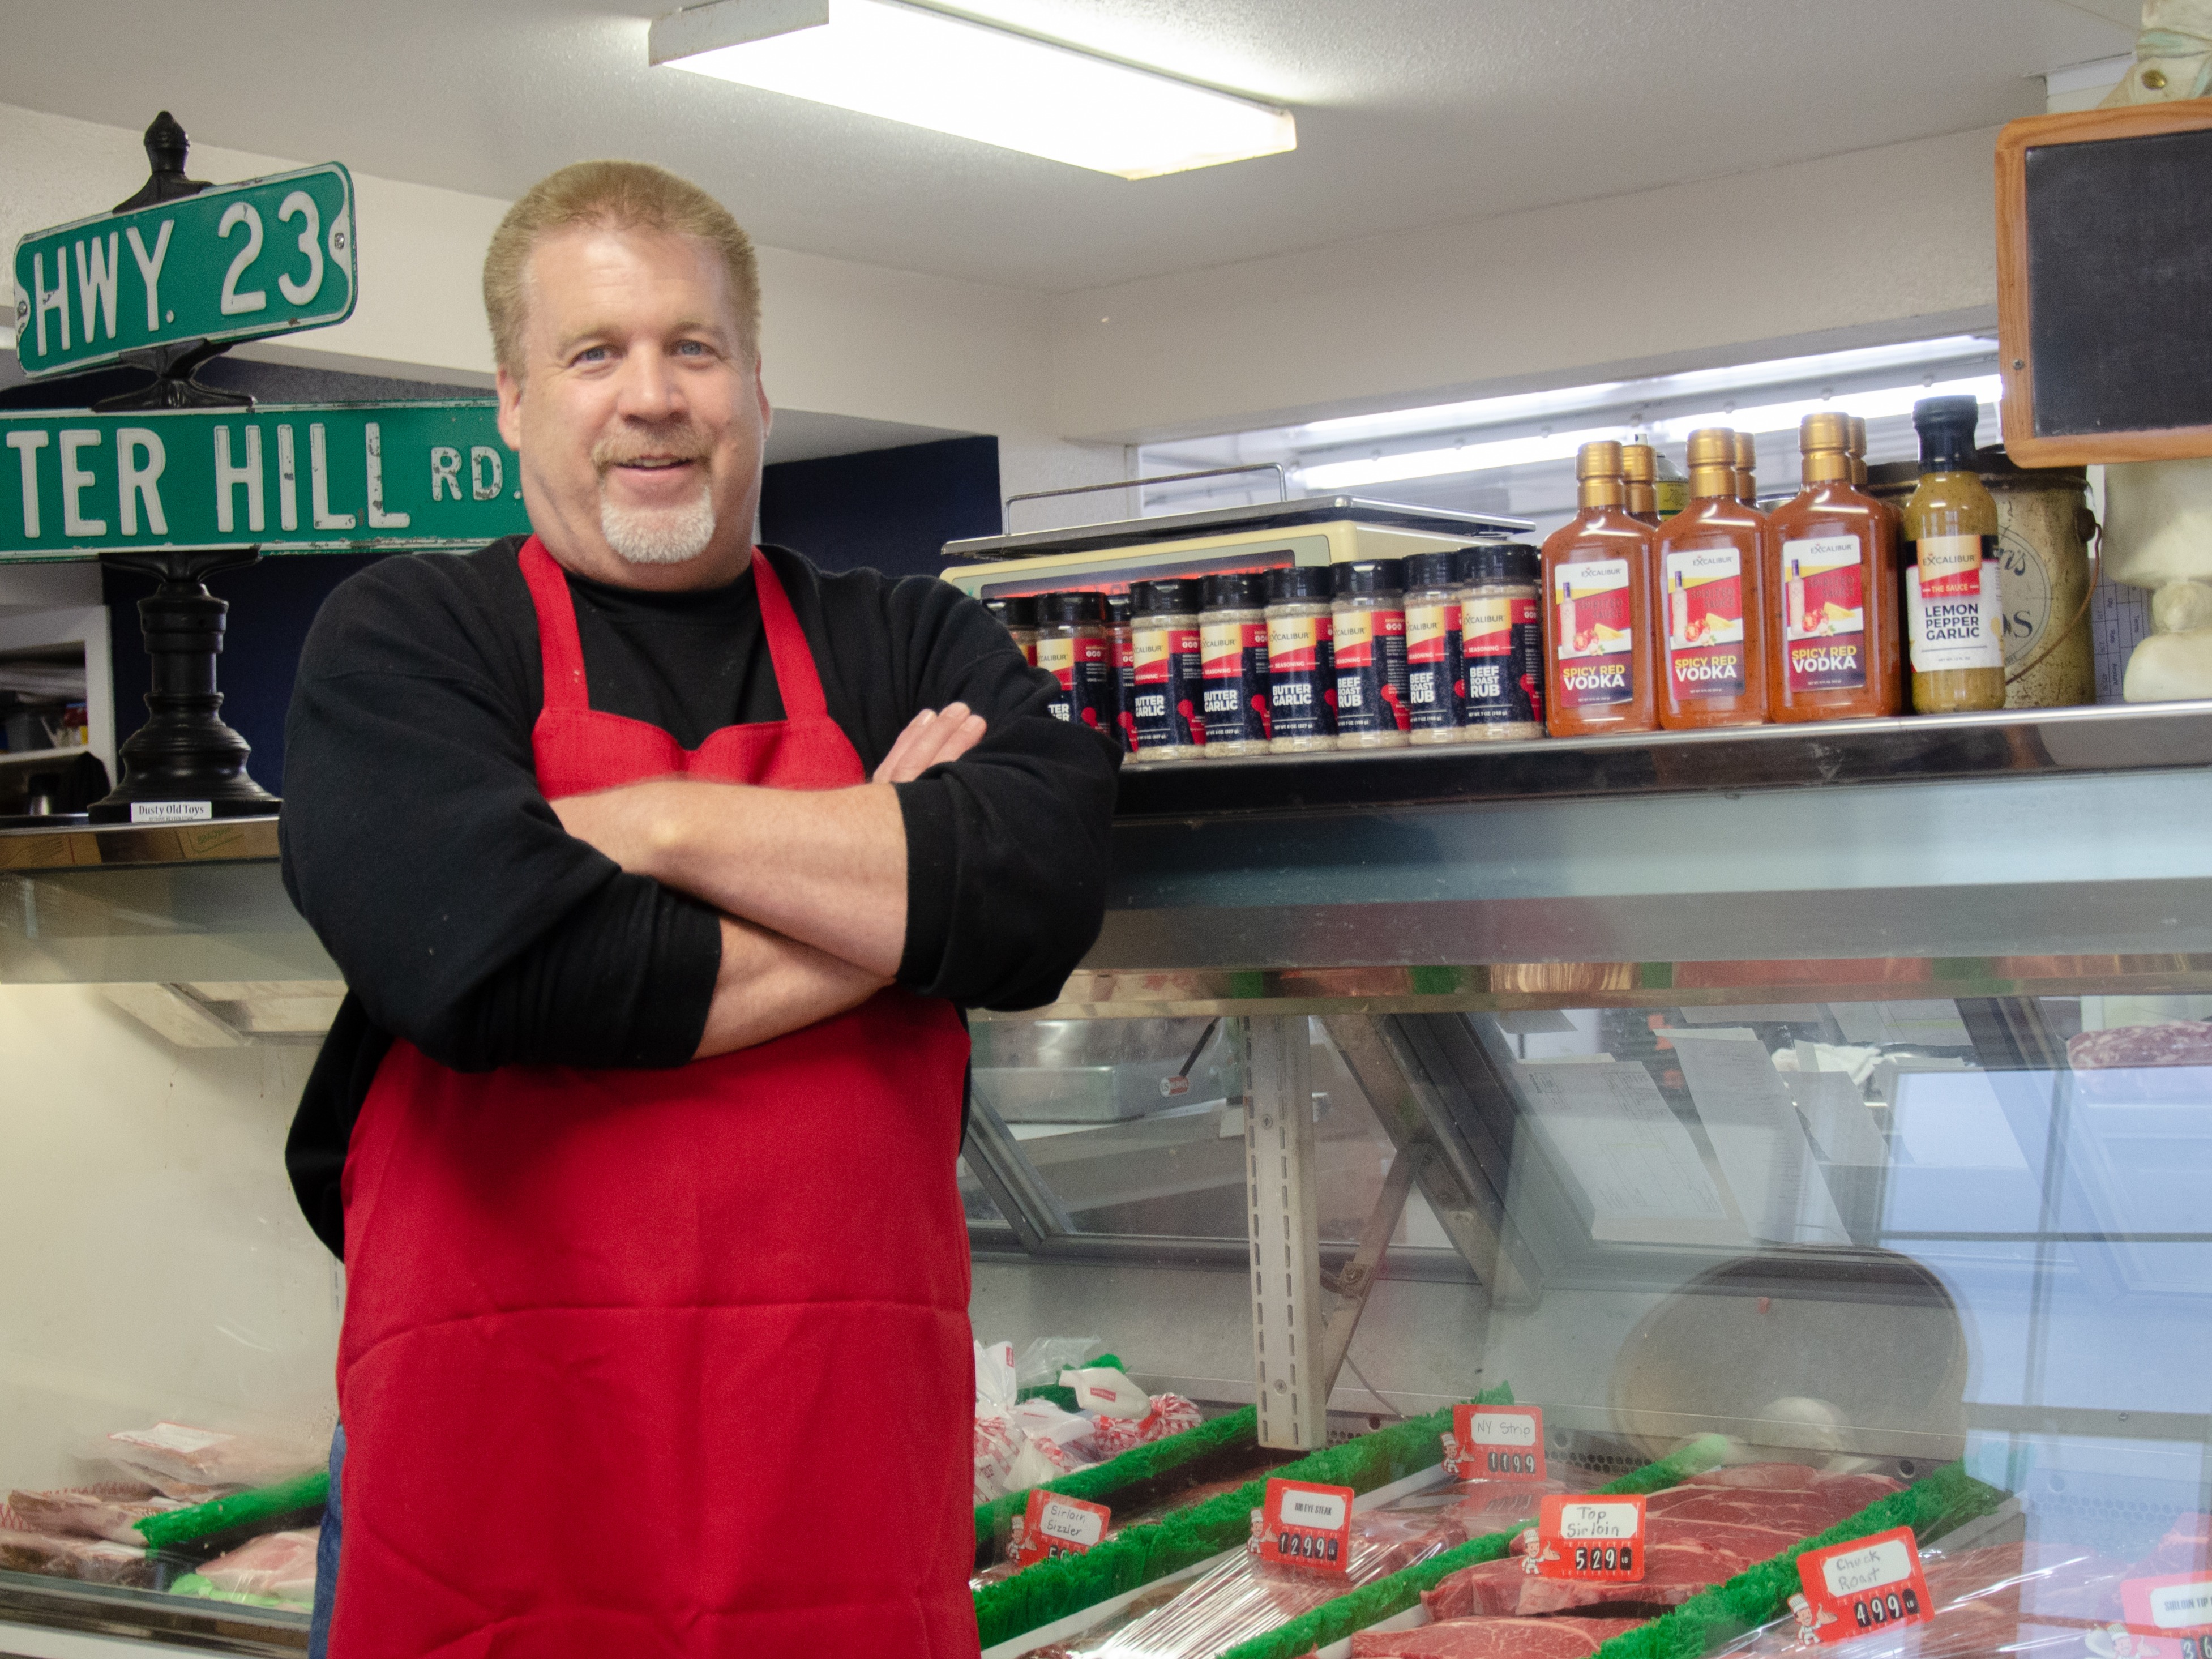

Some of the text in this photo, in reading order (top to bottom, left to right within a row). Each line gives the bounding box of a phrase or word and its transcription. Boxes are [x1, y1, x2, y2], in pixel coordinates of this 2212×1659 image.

[33, 190, 325, 357] HWY. 23
[5, 422, 522, 539] TER HILL RD.
[1811, 544, 1852, 554] EXCALIBUR
[1693, 557, 1732, 566] EXCALIBUR
[1923, 555, 1975, 566] EXCALIBUR
[1581, 568, 1621, 578] EXCALIBUR
[1807, 575, 1854, 588] SPIRITED
[1691, 587, 1734, 599] SPIRITED
[1822, 587, 1854, 598] SAUCE
[1578, 598, 1623, 610] SPIRITED
[1704, 598, 1734, 609] SAUCE
[1593, 609, 1623, 619] SAUCE
[1925, 604, 1978, 618] LEMON
[1926, 616, 1979, 630] PEPPER
[1926, 627, 1980, 641] GARLIC
[1792, 645, 1857, 661] SPICY RED
[1675, 655, 1737, 669] SPICY RED
[1792, 655, 1857, 673] VODKA
[1410, 672, 1434, 683] BEEF
[1470, 666, 1499, 677] BEEF
[1563, 664, 1625, 678] SPICY RED
[1675, 665, 1737, 682] VODKA
[1337, 677, 1361, 688] BEEF
[1410, 682, 1434, 691] ROAST
[1470, 676, 1499, 686] ROAST
[1564, 674, 1625, 691] VODKA
[1204, 689, 1237, 702] BUTTER
[1272, 683, 1311, 696] BUTTER
[1338, 687, 1361, 696] ROAST
[1471, 684, 1500, 698] RUB
[1135, 695, 1165, 707] BUTTER
[1273, 694, 1312, 707] GARLIC
[1338, 695, 1362, 708] RUB
[1411, 690, 1435, 703] RUB
[1136, 705, 1165, 717] GARLIC
[1204, 700, 1238, 712] GARLIC
[139, 804, 204, 816] Dusty Old Toys
[1478, 1421, 1530, 1438] NY Strip
[1051, 1505, 1086, 1524] Sirloin
[1304, 1504, 1313, 1513] EYE
[1315, 1505, 1332, 1516] STEAK
[1577, 1506, 1607, 1524] Top
[1047, 1520, 1083, 1536] Sizzler
[1567, 1522, 1619, 1538] Sirloin
[1836, 1550, 1881, 1571] Chuck
[1838, 1567, 1880, 1590] Roast
[2164, 1598, 2194, 1611] SIRLOIN
[2196, 1597, 2209, 1607] TIP
